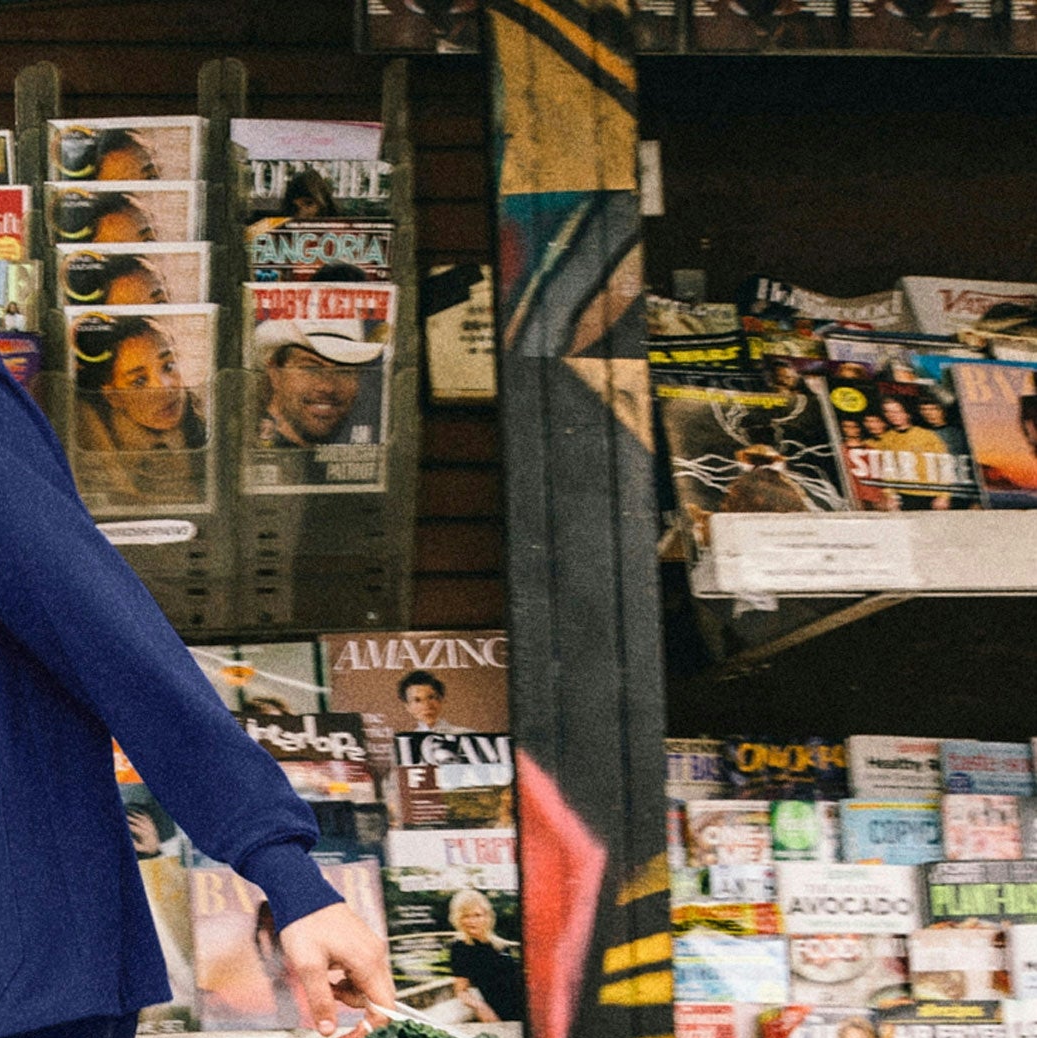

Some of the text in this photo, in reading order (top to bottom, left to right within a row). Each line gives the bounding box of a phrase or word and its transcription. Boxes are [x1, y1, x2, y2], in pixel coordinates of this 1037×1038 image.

[254, 234, 385, 265] FANGORIA
[253, 290, 390, 320] TOBY KEITH
[849, 448, 919, 480] STAR
[790, 896, 911, 915] AVOCADO
